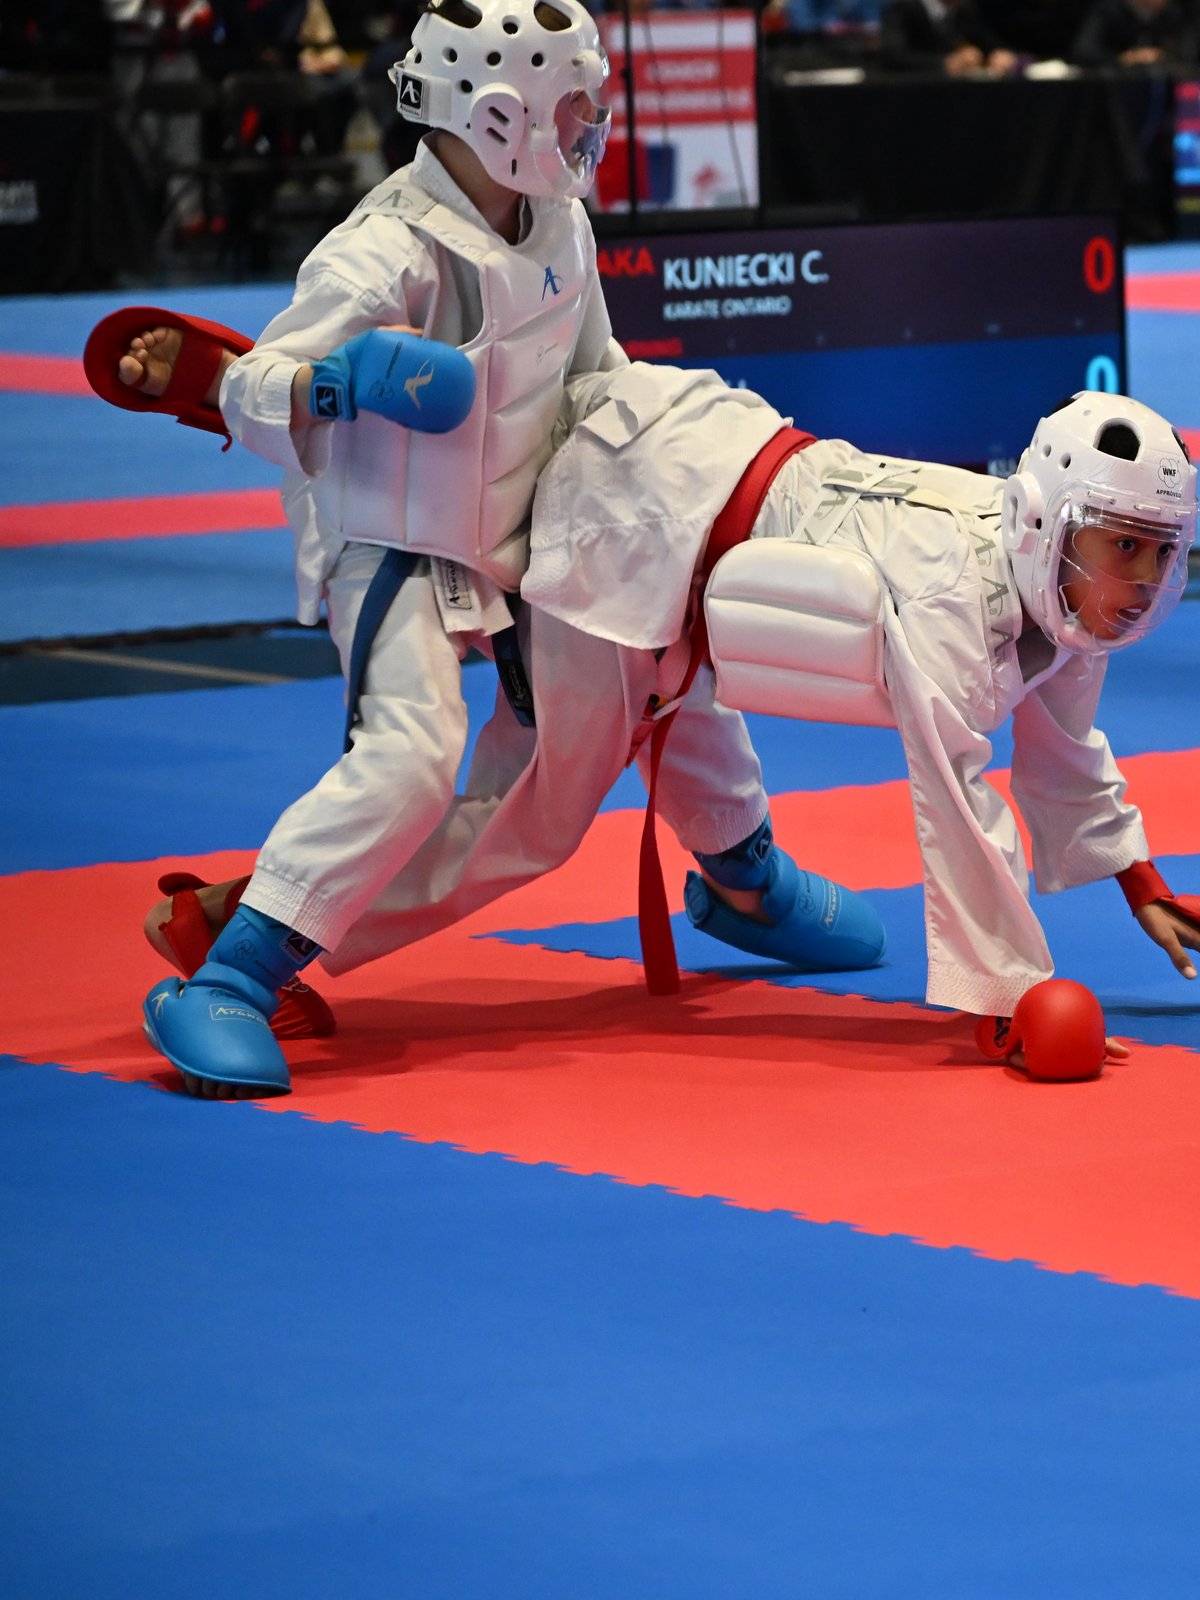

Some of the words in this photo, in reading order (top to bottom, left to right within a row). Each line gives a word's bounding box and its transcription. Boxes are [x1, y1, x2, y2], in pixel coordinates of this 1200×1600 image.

[597, 248, 654, 275] AKA
[664, 253, 794, 289] KUNIECKI
[801, 250, 829, 283] C.
[1084, 237, 1115, 292] 0
[664, 301, 719, 320] KARATE
[721, 296, 791, 318] ONTARIO
[1163, 467, 1176, 476] WKF
[1156, 489, 1181, 498] APPROVED
